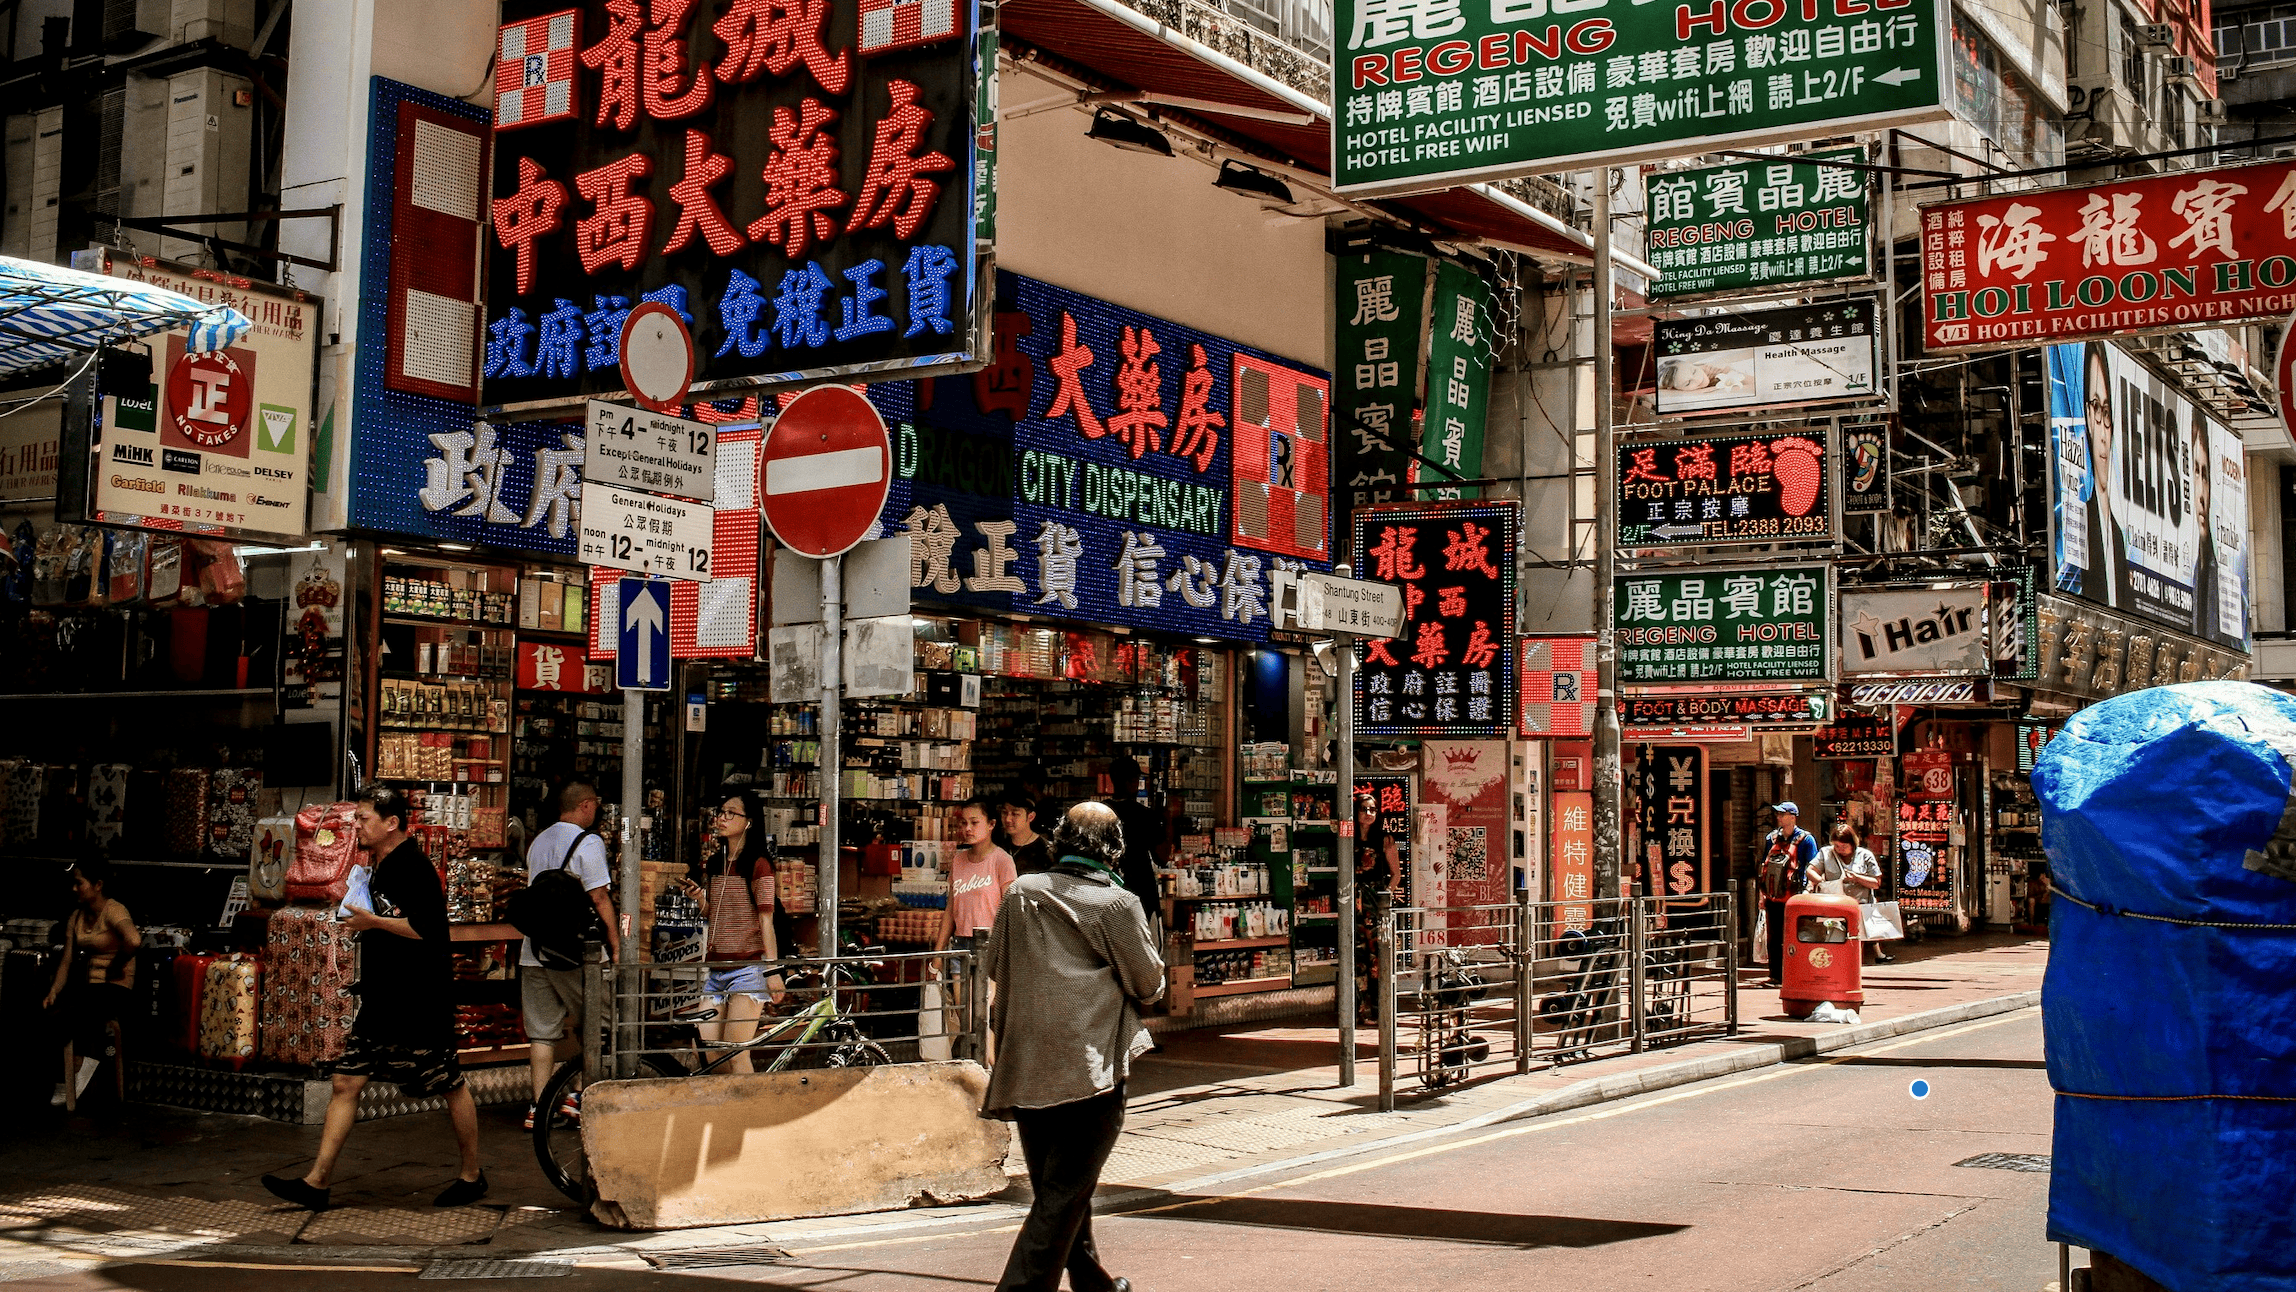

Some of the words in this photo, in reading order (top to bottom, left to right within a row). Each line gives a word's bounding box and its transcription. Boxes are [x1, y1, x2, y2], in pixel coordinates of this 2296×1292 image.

[1352, 17, 1617, 90] REGENG
[1605, 38, 1736, 89] 豪華套房
[1744, 13, 1919, 69] 歡迎自由行
[1346, 80, 1463, 128] 持牌賓館
[1472, 60, 1597, 109] 酒店設備
[1346, 128, 1410, 150] HOTEL
[1414, 113, 1501, 140] FACILITY
[1506, 101, 1592, 128] LIENSED
[1346, 146, 1410, 170] HOTEL
[1414, 140, 1463, 162] FREE
[1464, 133, 1510, 153] WIFI
[492, 80, 955, 295] 中西大藥房
[1650, 218, 1755, 249] REGENG
[1775, 205, 1862, 235] HOTEL
[1700, 242, 1748, 264] 酒店設備
[1749, 234, 1799, 259] 豪華套房
[1800, 228, 1862, 253] 歡迎自由行
[1926, 212, 1945, 291] 酒店設備
[1948, 210, 1966, 289] 純粹租房
[1678, 266, 1712, 280] FACILITY
[1713, 263, 1746, 276] LIENSED
[1651, 283, 1677, 294] HOTEL
[1678, 281, 1697, 291] FREE
[1697, 278, 1715, 289] WIFI
[1931, 282, 2034, 323] HOI
[2045, 264, 2199, 312] LOON
[484, 284, 694, 378] 政府註
[714, 244, 959, 358] 免稅正貨
[1976, 319, 2047, 340] HOTEL
[2051, 306, 2169, 333] FACILITEIS
[2174, 299, 2234, 321] OVER
[1715, 322, 1769, 336] Massage
[1764, 349, 1798, 360] Health
[1801, 344, 1846, 356] Massage
[1437, 293, 1478, 500] 麗晶賓
[176, 414, 192, 436] NO
[197, 424, 238, 446] FAKES
[595, 422, 617, 441] 下午
[657, 435, 679, 453] 午夜
[599, 409, 614, 421] pm
[650, 419, 685, 435] midnight
[688, 430, 709, 456] 12
[599, 443, 631, 461] Except
[632, 450, 665, 467] General
[666, 458, 703, 475] Holidays
[2119, 375, 2182, 529] IELTS
[111, 474, 166, 494] Garfield
[254, 466, 294, 480] DELSEY
[617, 464, 684, 490] 公眾假期例外
[1623, 480, 1679, 500] FOOT
[1683, 474, 1773, 497] PALACE
[178, 483, 237, 503] Rilakkuma
[611, 493, 646, 510] General
[649, 500, 687, 518] Holidays
[1021, 449, 1077, 509] CITY
[1084, 463, 1224, 536] DISPENSARY
[1647, 494, 1750, 520] 正宗按摩
[623, 513, 673, 537] 公眾假期
[1622, 524, 1652, 542] 2/F
[1783, 515, 1826, 533] 2093
[583, 542, 605, 559] 中午
[654, 554, 676, 571] 午夜
[584, 527, 607, 539] noon
[646, 538, 685, 553] midnight
[688, 547, 709, 573] 12
[1370, 521, 1499, 580] 龍城
[1323, 582, 1359, 602] Shantung
[1361, 588, 1384, 603] Street
[1620, 572, 1818, 622] 麗晶賓館
[1338, 607, 1370, 628] 山東街
[1883, 600, 1975, 654] Hair
[1737, 621, 1821, 643] HOTEL
[1726, 661, 1752, 670] HOTEL
[1752, 660, 1786, 669] FACILITY
[1787, 659, 1820, 668] LIENSED
[1761, 643, 1821, 659] 歡迎自由行
[1726, 669, 1763, 677] HOTEL
[1765, 668, 1791, 677] FREE
[1793, 668, 1819, 676] WIFI
[1370, 696, 1494, 722] 信心保證
[1633, 700, 1673, 716] FOOT
[1676, 701, 1686, 714] &
[1689, 700, 1732, 715] BODY
[1735, 697, 1810, 713] MASSAGE
[1834, 740, 1891, 753] 62213330
[1563, 805, 1588, 933] 維特健靈
[953, 874, 993, 898] Babies
[1420, 930, 1446, 945] 168
[653, 941, 700, 964] Knoppers
